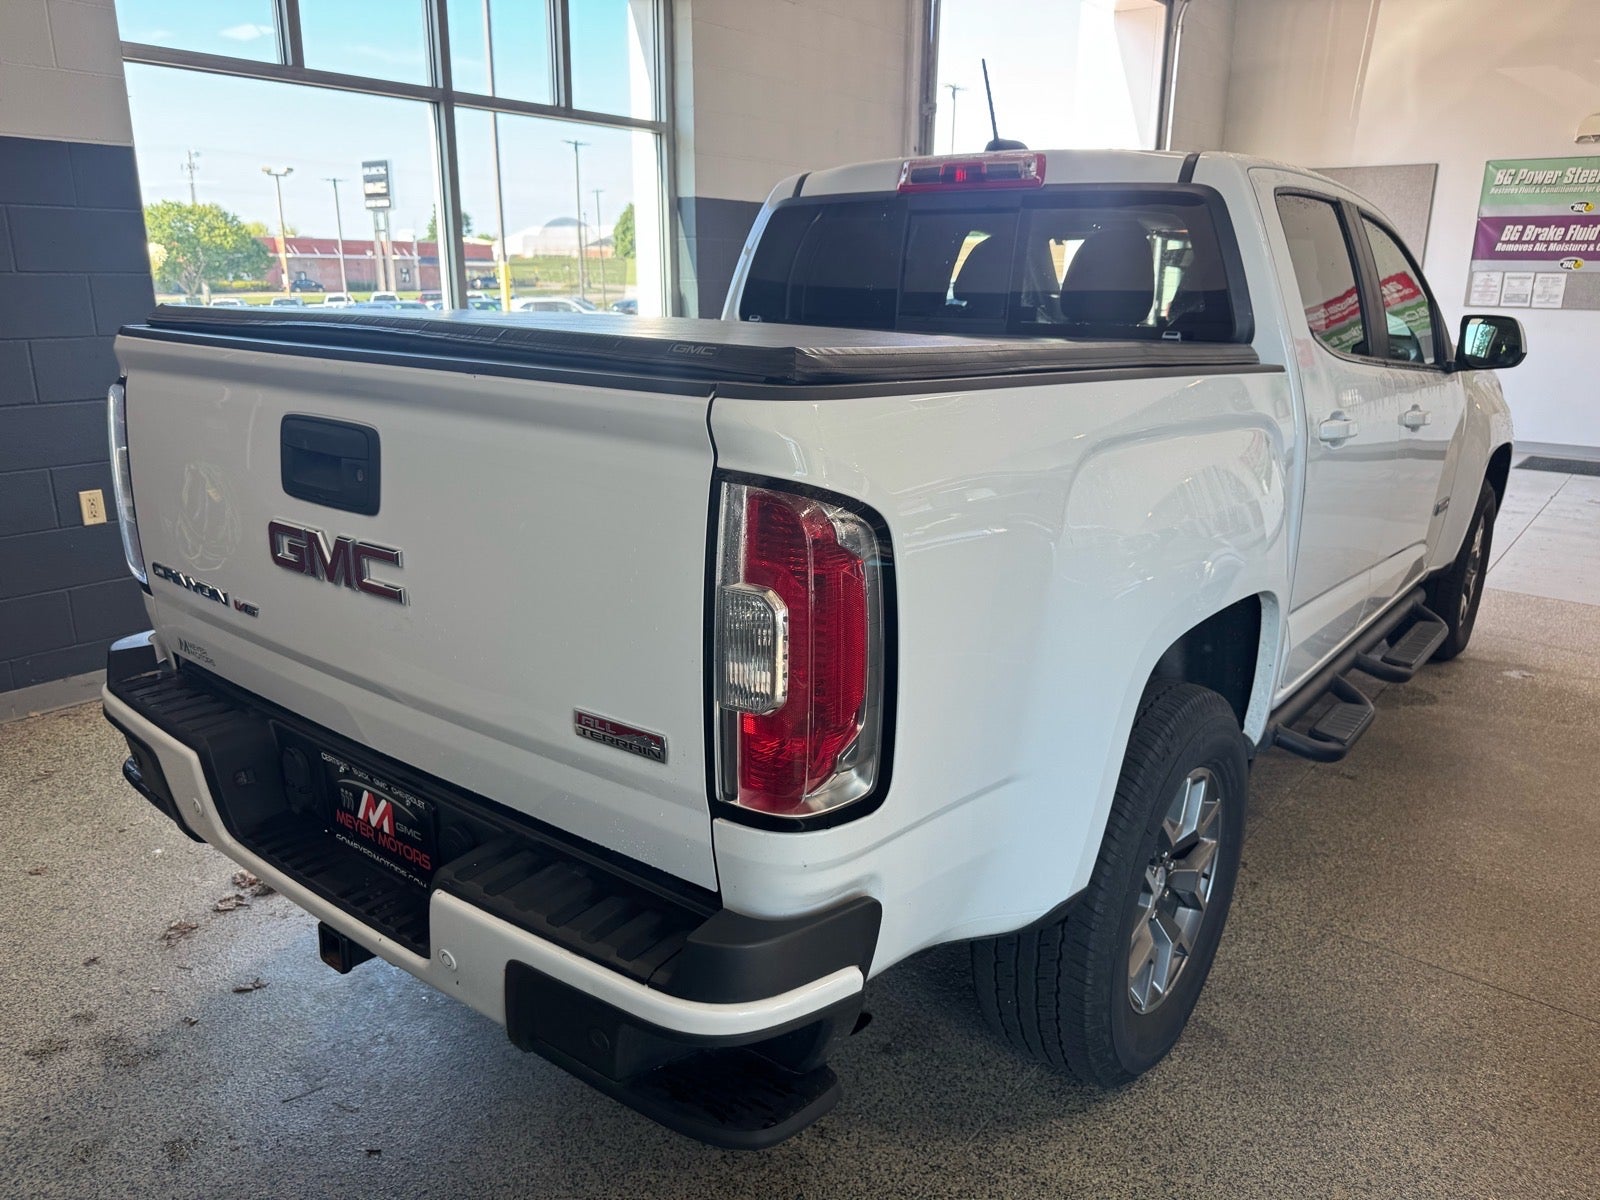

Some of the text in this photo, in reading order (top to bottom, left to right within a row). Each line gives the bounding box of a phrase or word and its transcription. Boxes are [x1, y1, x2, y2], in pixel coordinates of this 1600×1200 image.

[1494, 168, 1517, 187] BG
[1514, 168, 1563, 186] Power
[1500, 224, 1600, 241] BG Brake Fluid
[1494, 243, 1534, 252] Removes
[1547, 242, 1588, 252] Moisture
[672, 343, 717, 356] GMC
[268, 519, 407, 605] GMC
[152, 561, 260, 618] CANYON V6
[582, 715, 616, 734] ALL
[578, 727, 661, 760] TERRAIN
[335, 808, 432, 871] MEYER MOTORS
[396, 822, 423, 841] GMC
[335, 833, 427, 889] GOMEYERMOTORSCOM
